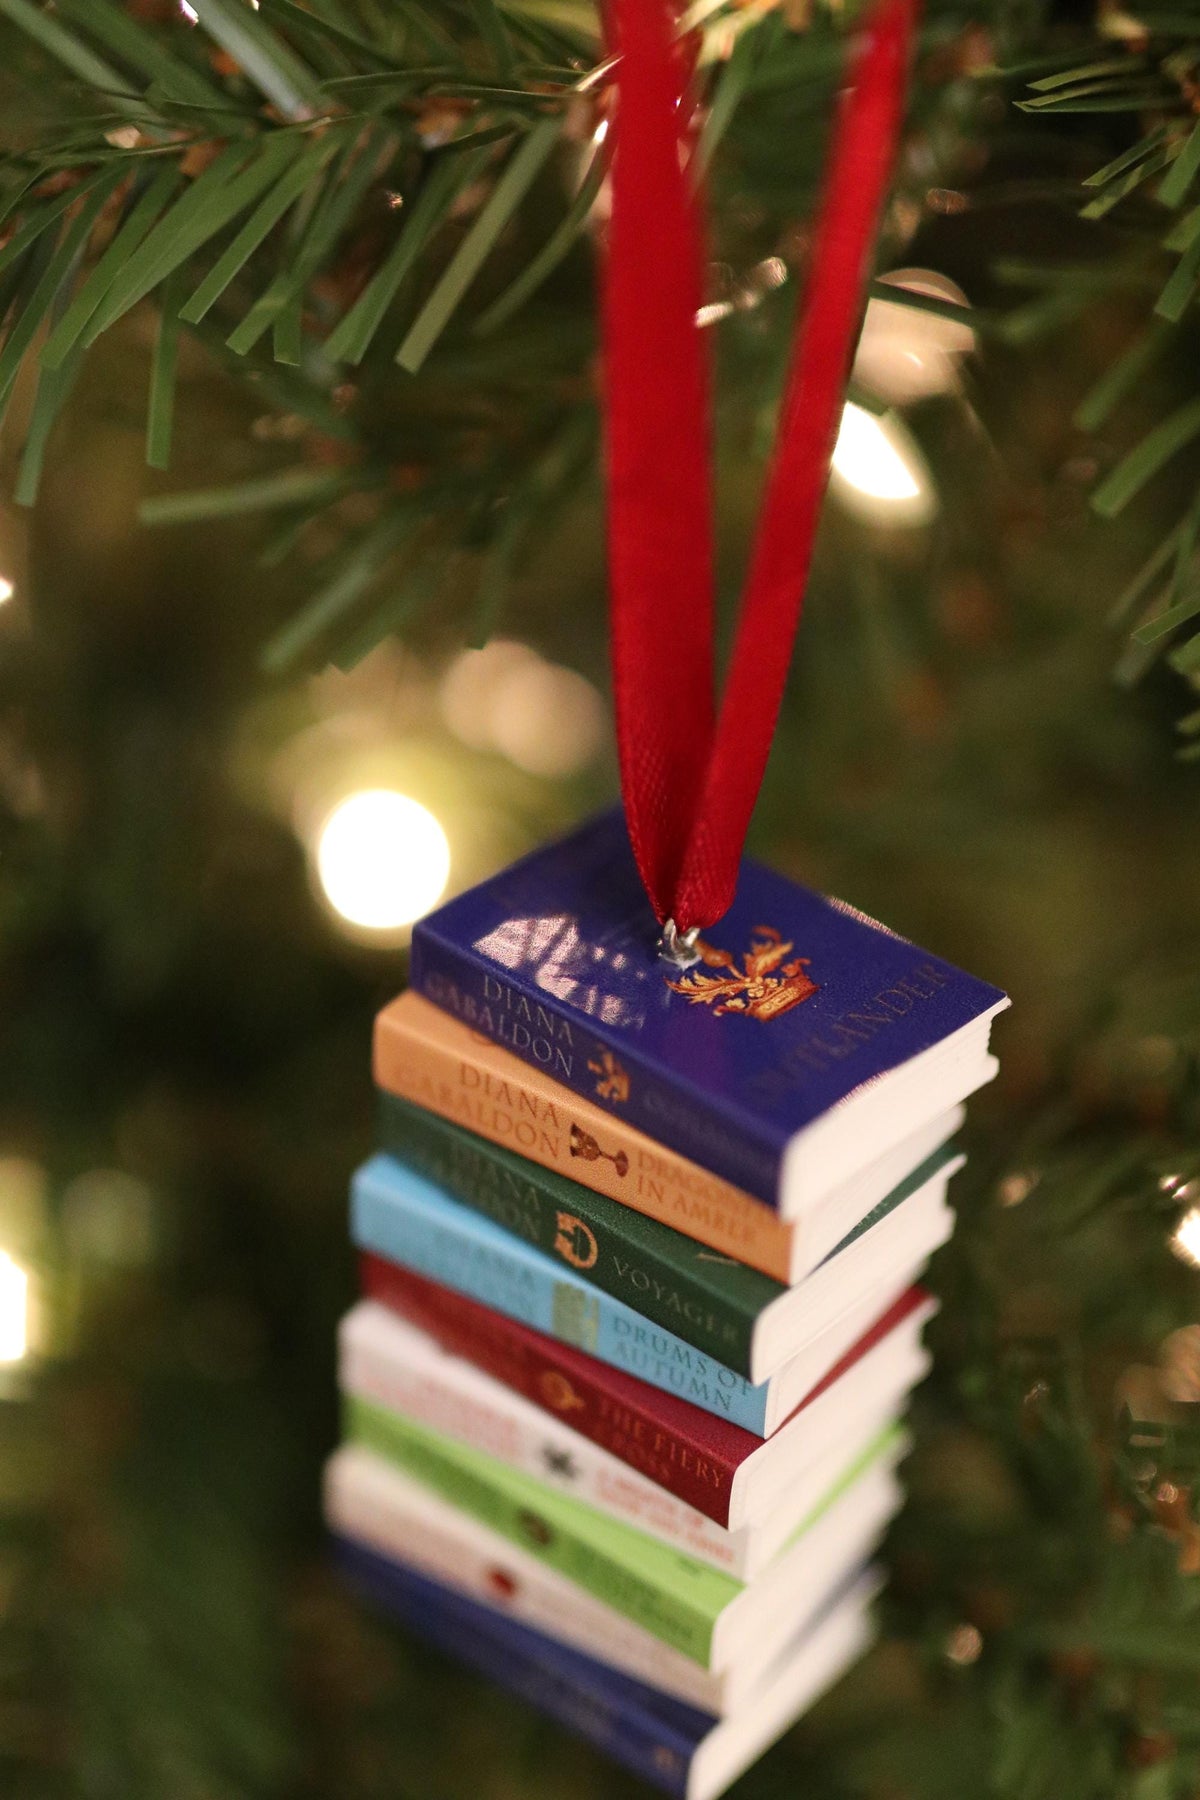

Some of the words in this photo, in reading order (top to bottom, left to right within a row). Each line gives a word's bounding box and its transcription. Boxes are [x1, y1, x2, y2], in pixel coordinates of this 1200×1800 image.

[483, 975, 574, 1047] DIANA
[459, 1062, 560, 1128] DIANA
[636, 1175, 666, 1204] IN
[613, 1255, 740, 1344] VOYAGER
[612, 1315, 709, 1376] DRUMS
[615, 1341, 732, 1412] AUTUMN
[653, 1432, 726, 1489] FIERY
